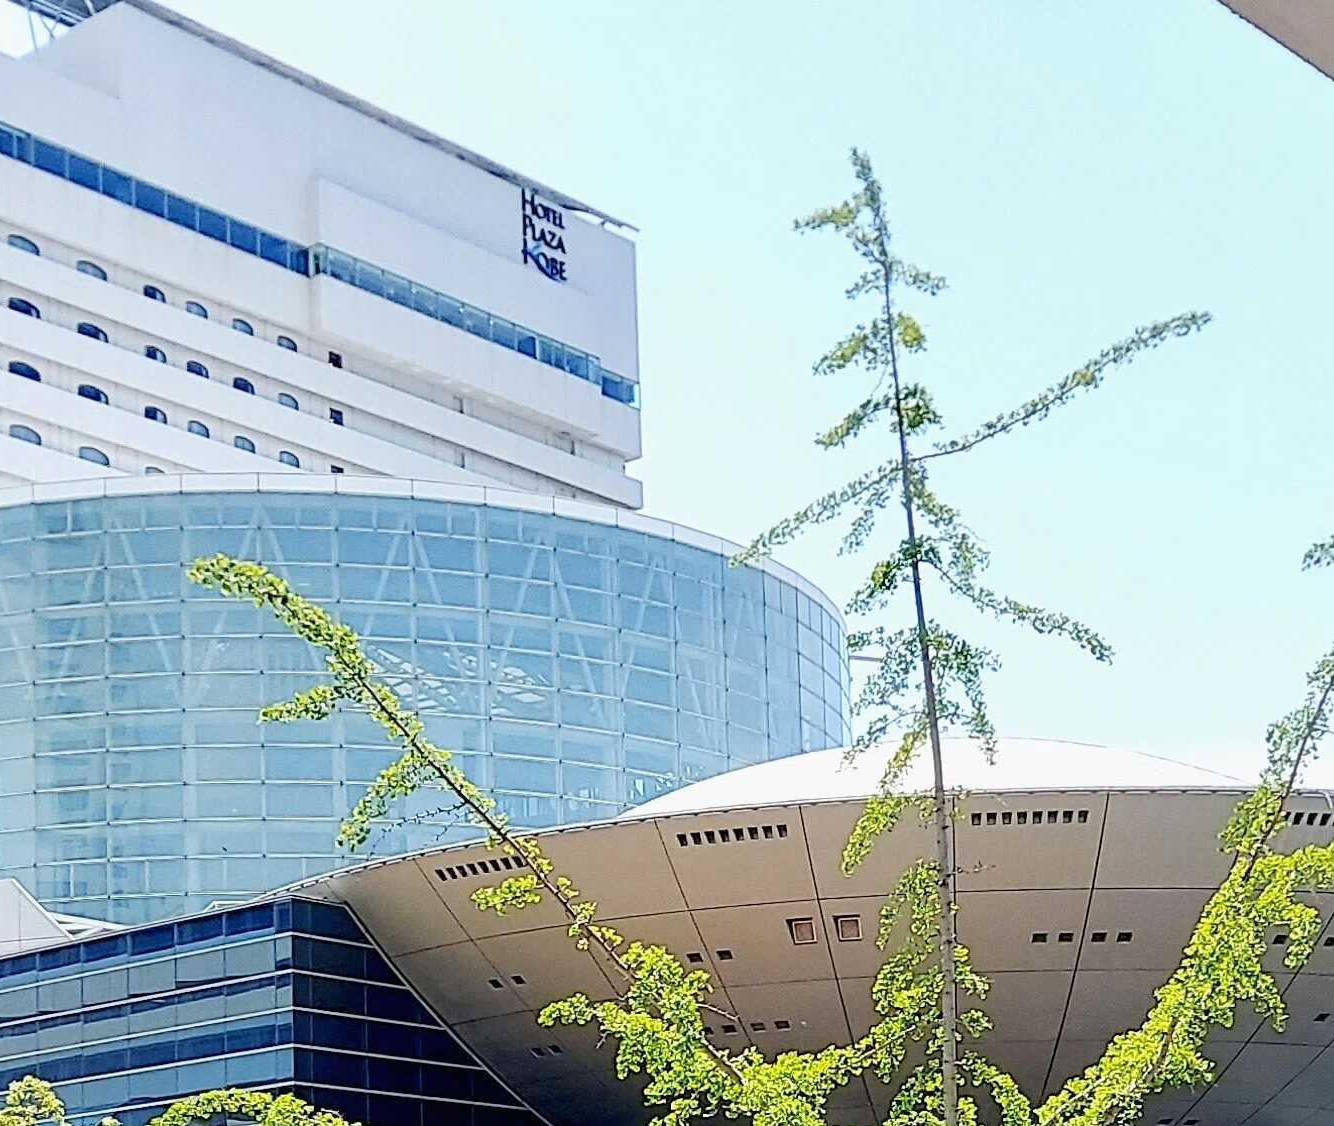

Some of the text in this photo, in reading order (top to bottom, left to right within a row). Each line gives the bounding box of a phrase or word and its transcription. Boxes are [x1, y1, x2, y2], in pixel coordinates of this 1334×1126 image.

[522, 188, 566, 230] HOTEL
[522, 213, 567, 254] PLAZA
[521, 238, 567, 282] KOBE
